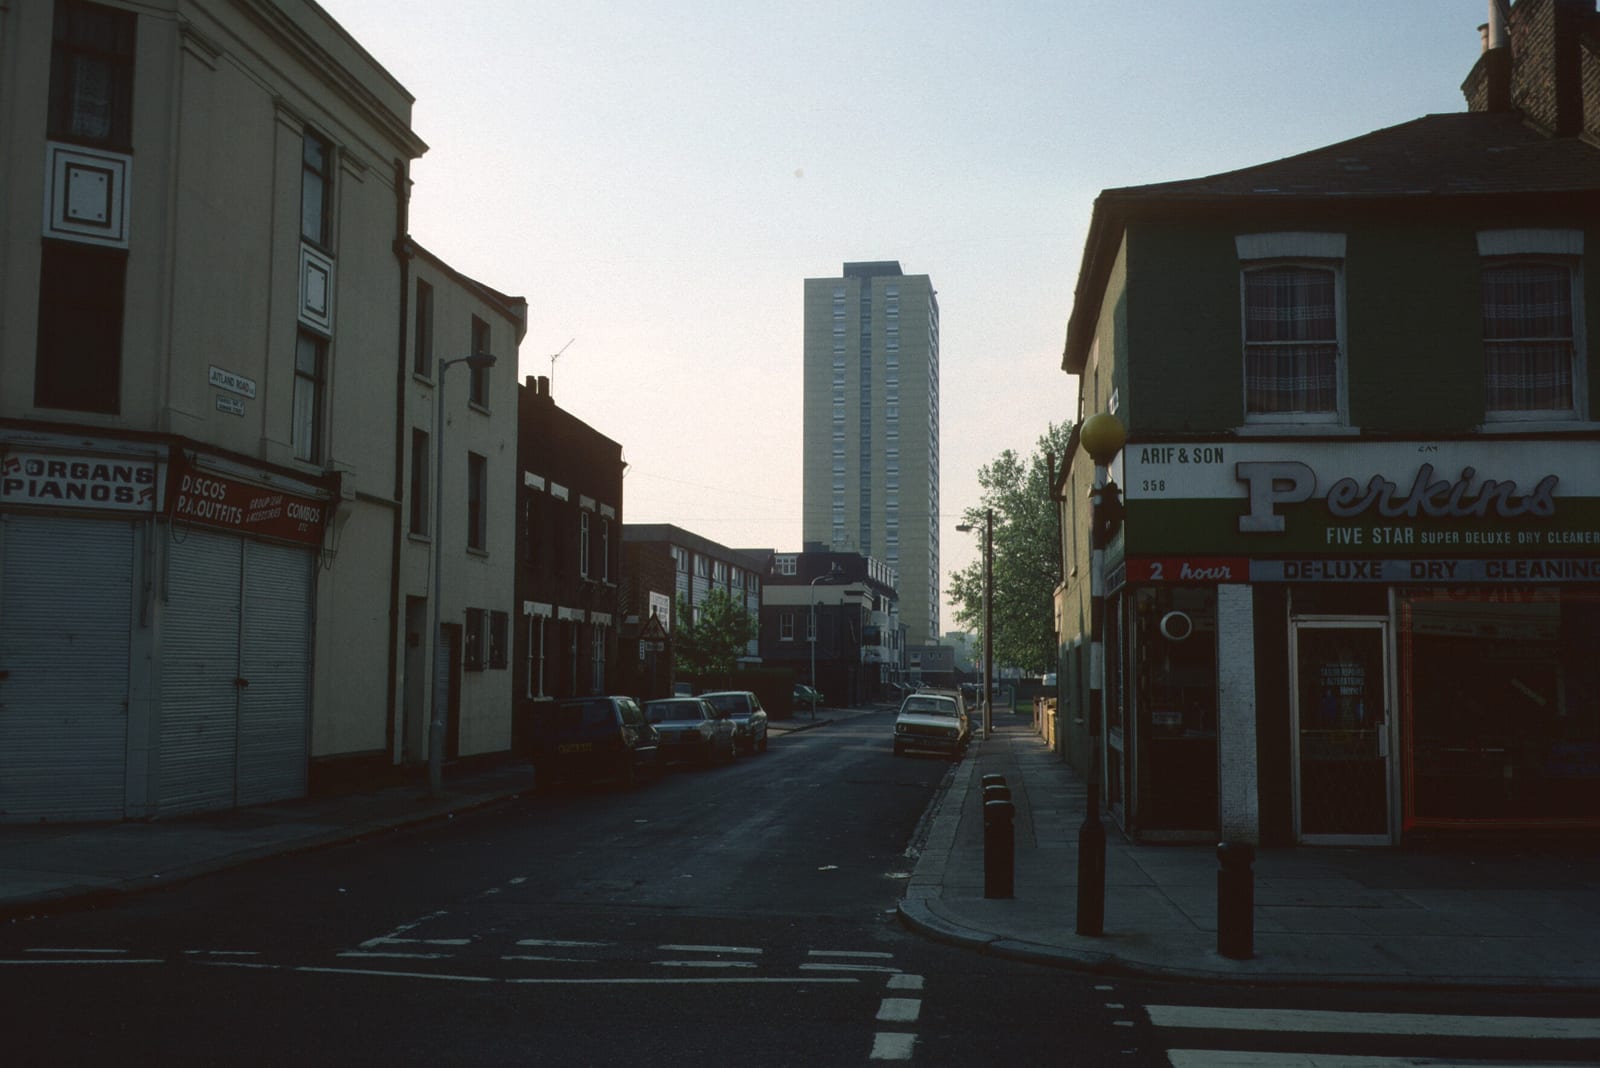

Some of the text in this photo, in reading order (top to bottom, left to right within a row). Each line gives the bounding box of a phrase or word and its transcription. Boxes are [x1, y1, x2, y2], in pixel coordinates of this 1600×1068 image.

[211, 371, 235, 387] JUTLAND
[236, 379, 250, 393] ROAD
[1141, 448, 1224, 464] ARIF & SON
[25, 458, 153, 484] ORGANS
[3, 478, 134, 503] PIANOS
[1142, 479, 1166, 492] 358
[1236, 461, 1559, 533] Perkins
[287, 502, 321, 523] COMBOS
[1326, 527, 1363, 544] FIVE
[1372, 527, 1415, 544] STAR
[1421, 531, 1460, 544] SUPER
[1465, 531, 1512, 544] DELUXE
[1518, 531, 1541, 544] DRY
[1150, 562, 1232, 580] 2 hour
[1283, 561, 1382, 579] DE-LUXE
[1410, 561, 1457, 579] DRY
